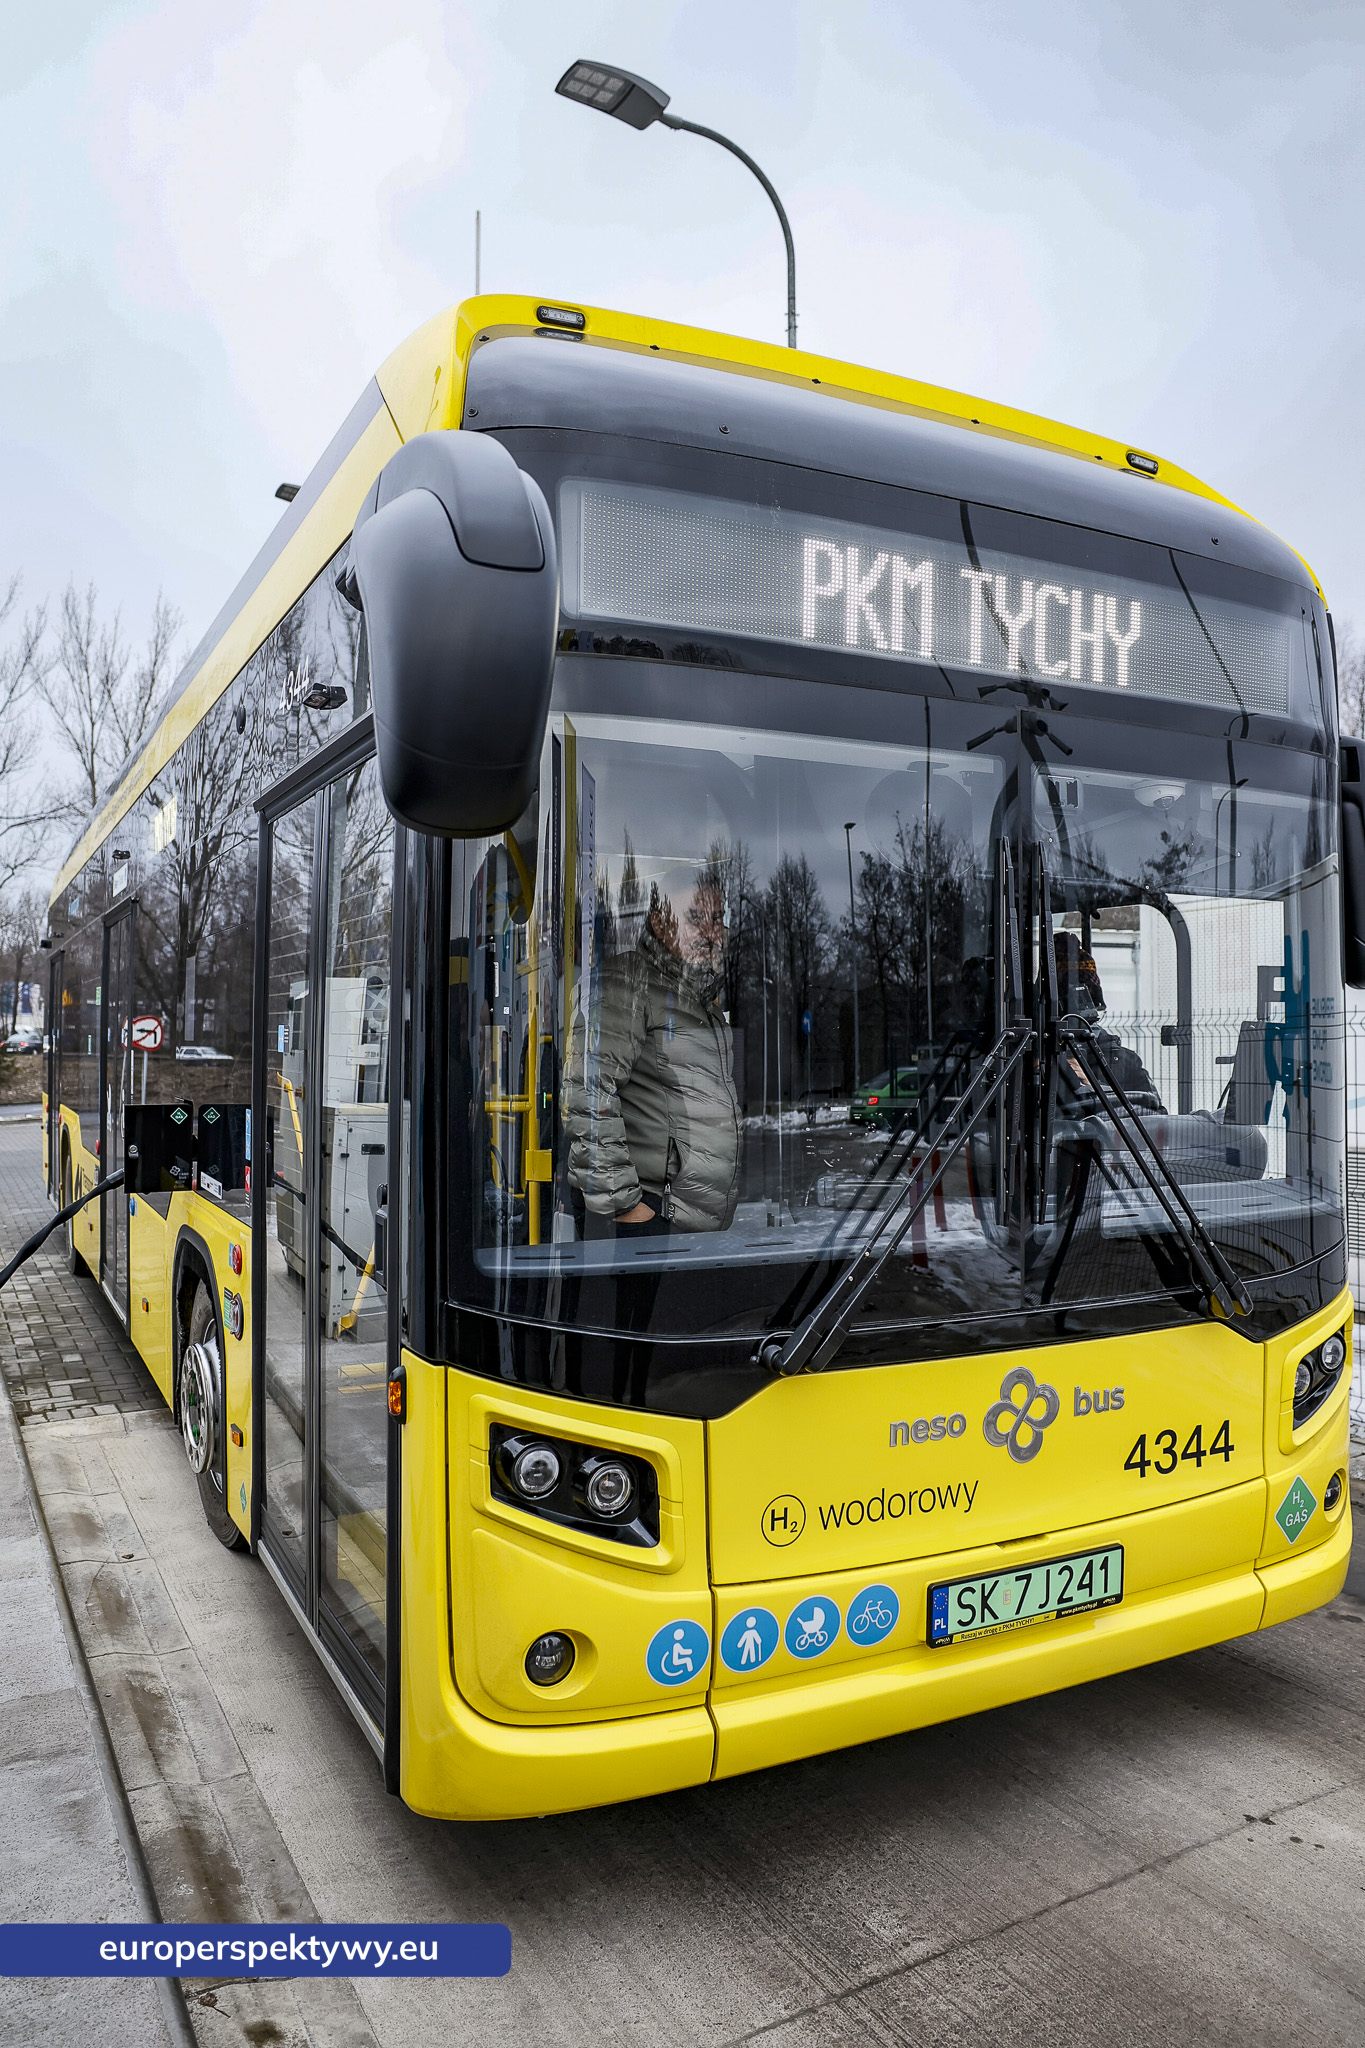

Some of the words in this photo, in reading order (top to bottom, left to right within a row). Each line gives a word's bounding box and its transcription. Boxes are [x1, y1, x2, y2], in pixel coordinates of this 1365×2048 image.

[803, 538, 934, 658] PKM
[960, 568, 1142, 687] TYCHY
[279, 654, 310, 715] 4344
[889, 1412, 967, 1448] neso
[1073, 1385, 1126, 1417] bus
[1123, 1420, 1235, 1479] 4344
[818, 1480, 979, 1531] wodorowy
[1285, 1508, 1308, 1527] GAS
[957, 1579, 1000, 1627] SK
[1014, 1555, 1110, 1616] 7J241
[934, 1617, 947, 1631] PL
[960, 1631, 978, 1640] Ruszaj
[1002, 1622, 1015, 1631] PKM
